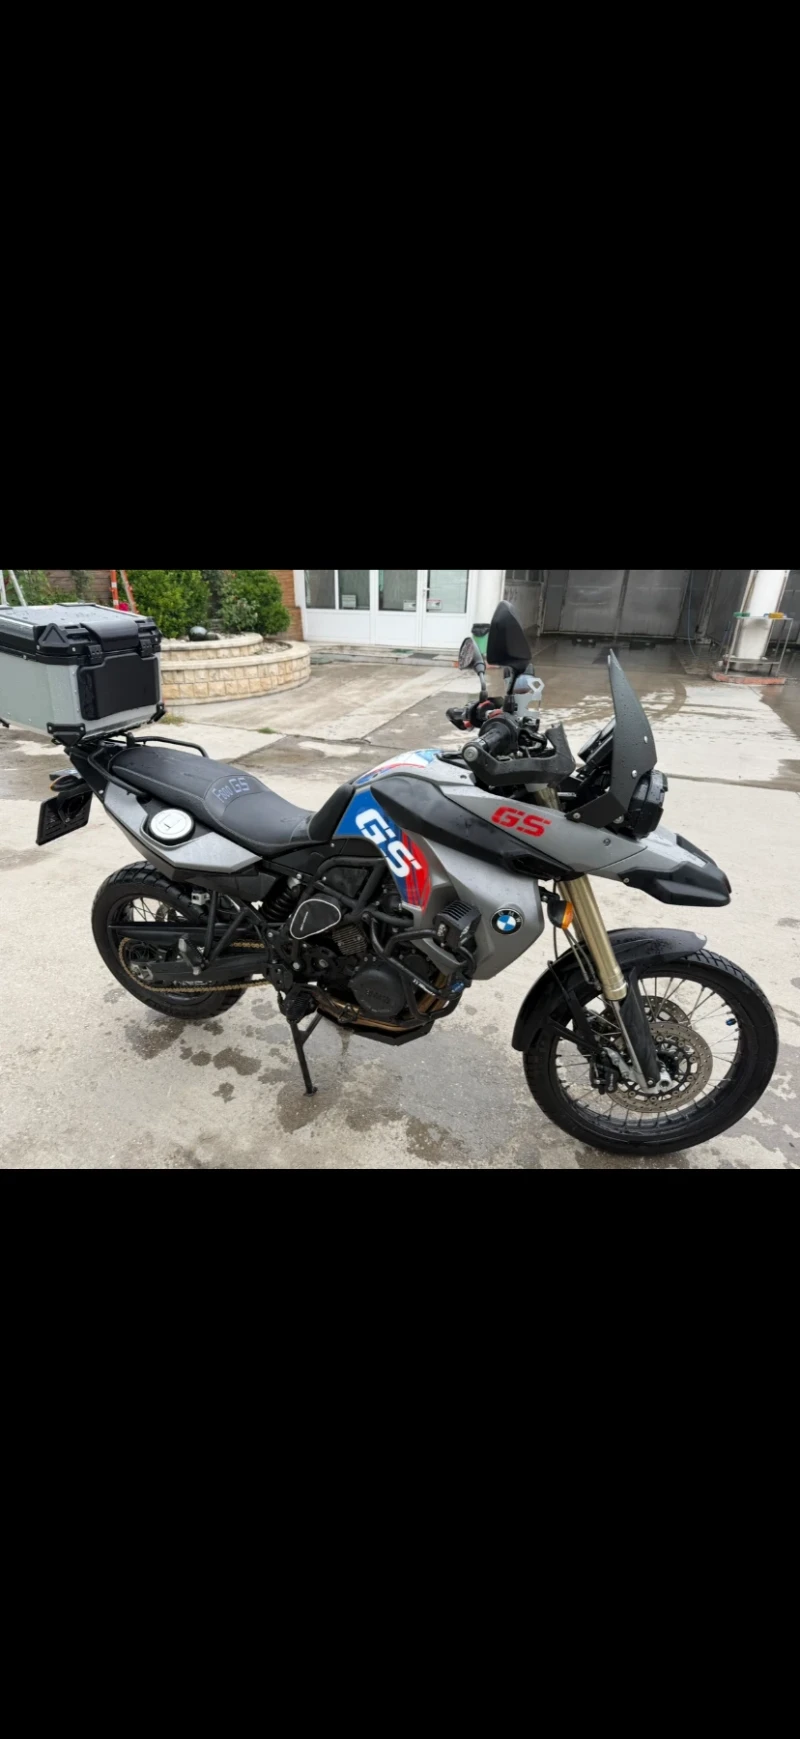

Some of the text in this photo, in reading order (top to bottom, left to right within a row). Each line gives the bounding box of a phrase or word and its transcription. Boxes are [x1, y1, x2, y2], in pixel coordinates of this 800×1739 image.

[229, 777, 250, 793] GS
[491, 806, 551, 837] GS
[355, 808, 422, 878] GS
[498, 910, 522, 923] BMW
